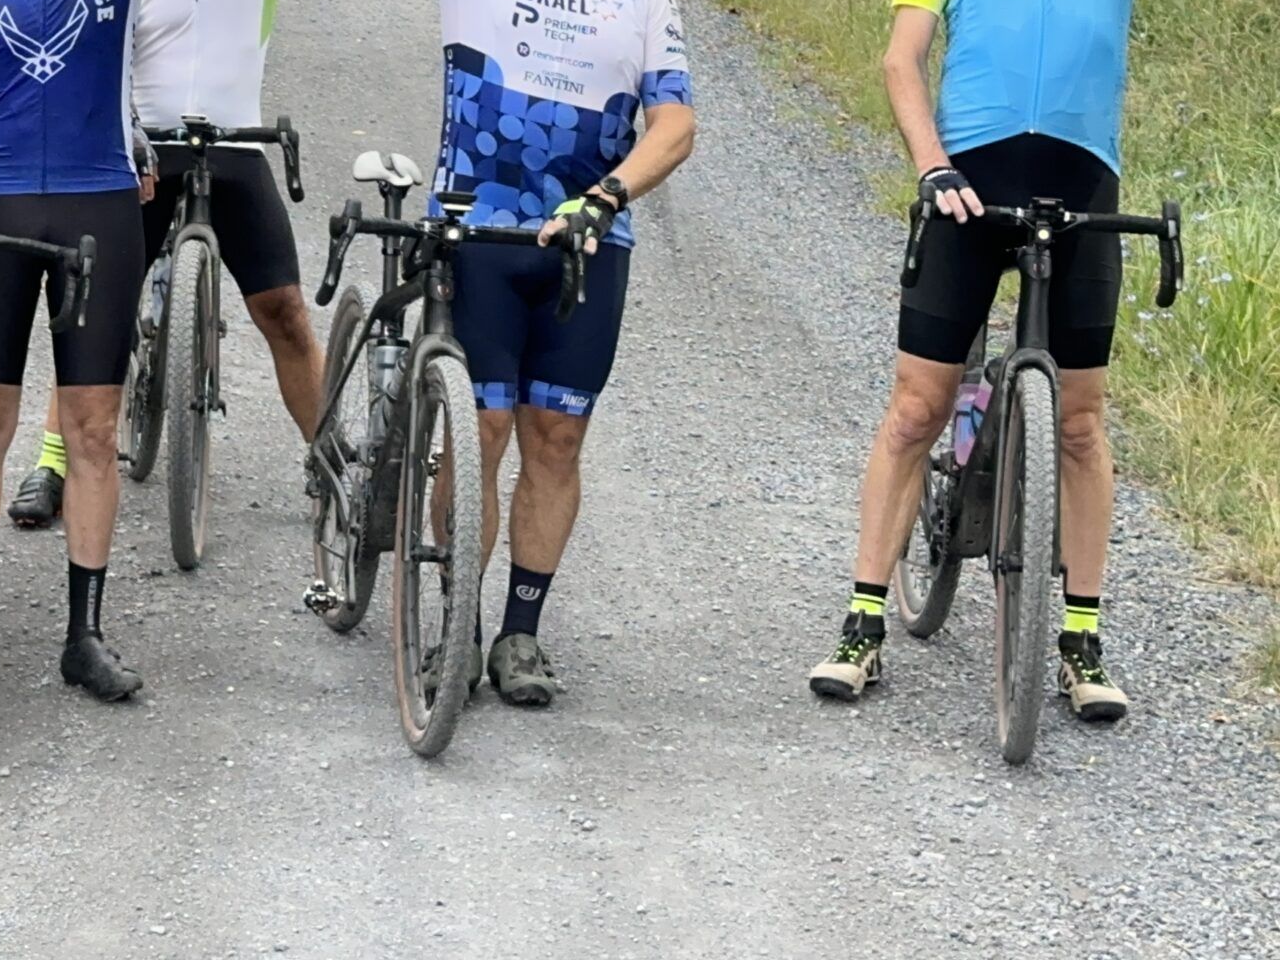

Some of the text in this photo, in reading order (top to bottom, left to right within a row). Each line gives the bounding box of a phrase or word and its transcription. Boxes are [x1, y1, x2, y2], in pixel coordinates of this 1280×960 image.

[543, 17, 598, 37] PREMIER
[543, 27, 576, 43] TECH
[523, 71, 586, 95] FANTINI
